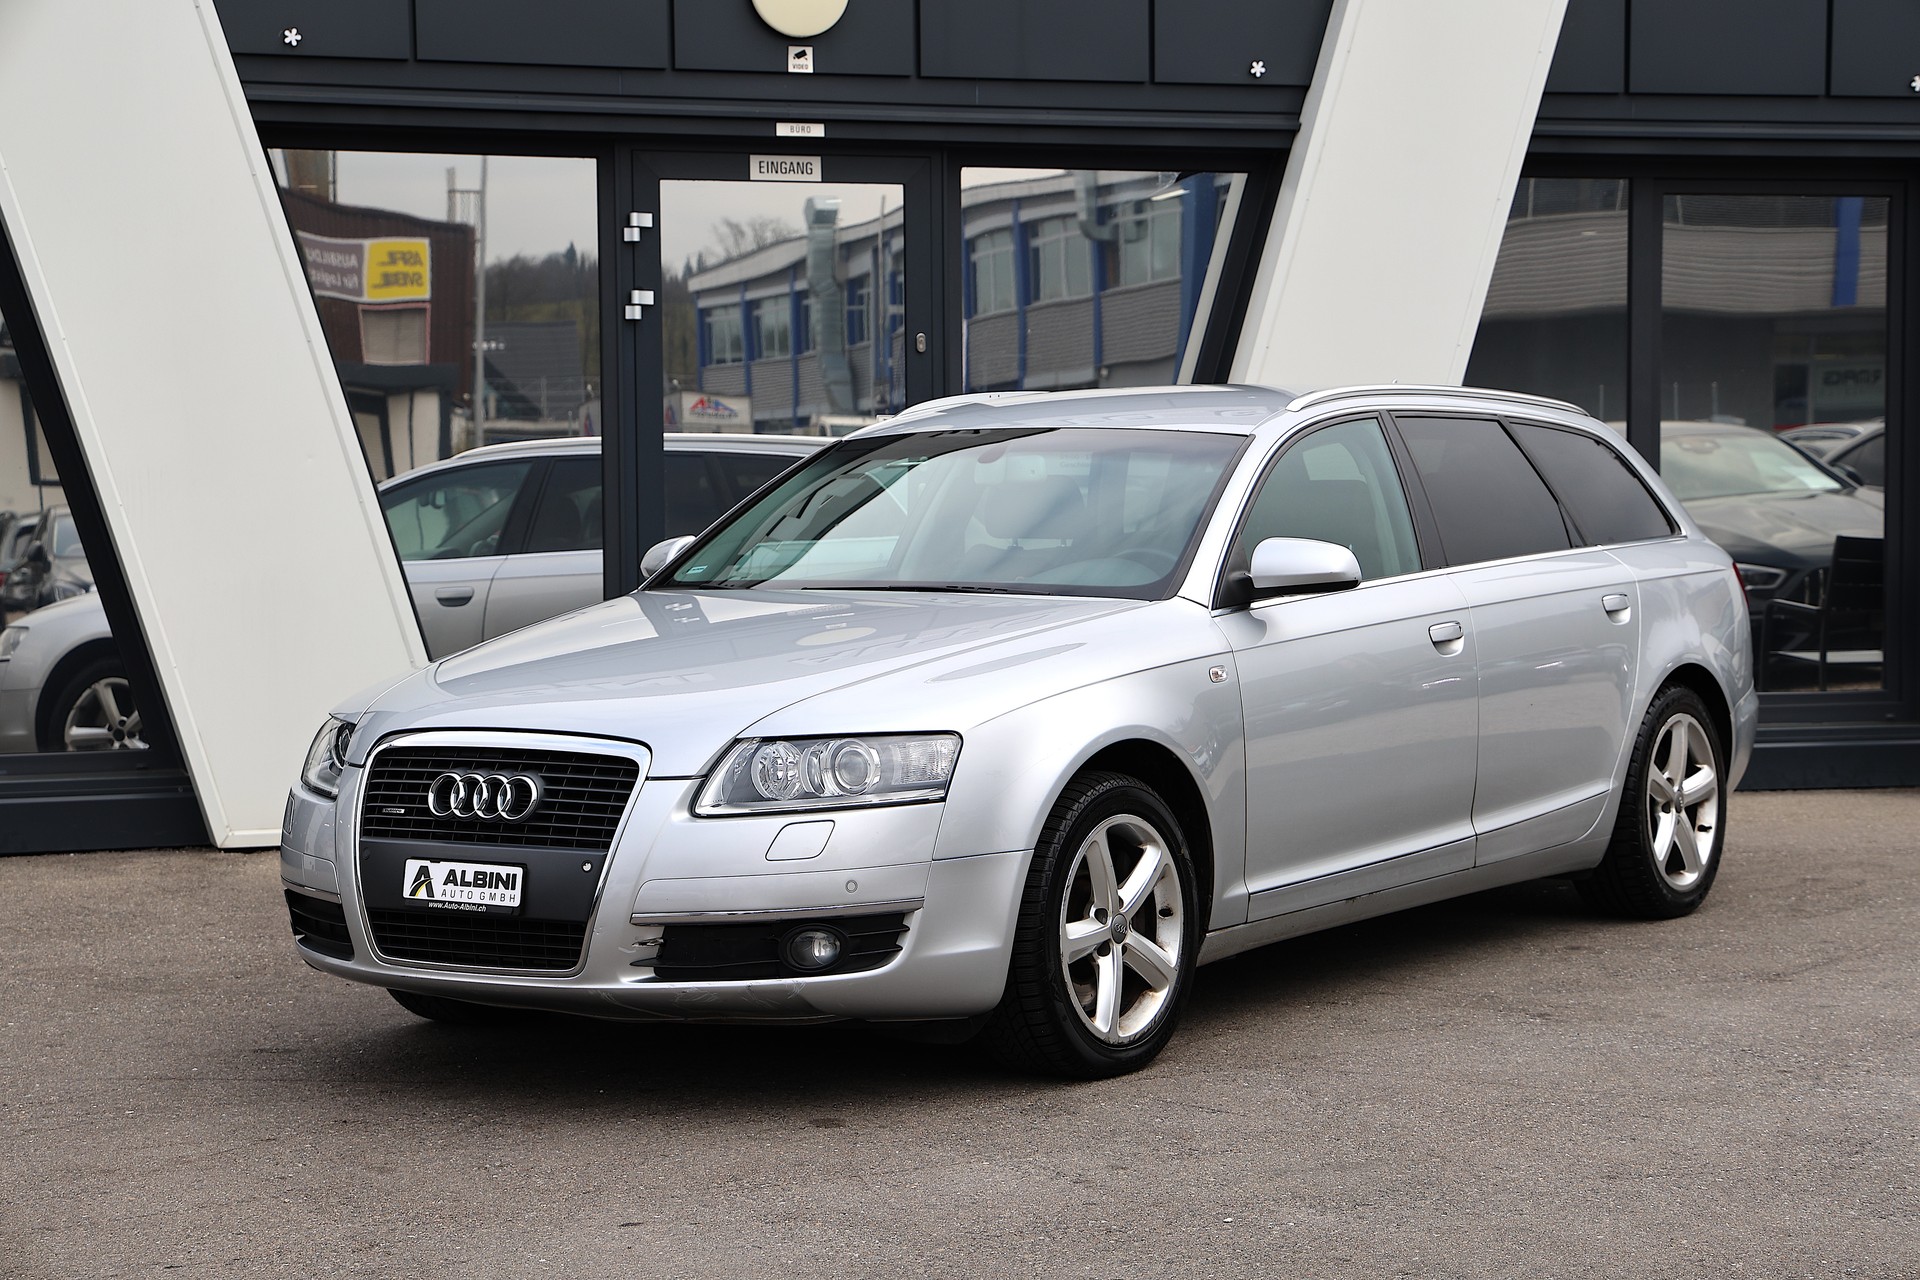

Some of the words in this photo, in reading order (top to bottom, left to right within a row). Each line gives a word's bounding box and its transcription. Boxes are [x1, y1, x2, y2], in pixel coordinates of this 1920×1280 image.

[790, 124, 812, 134] BÜRO
[758, 160, 813, 175] EINGANG
[443, 869, 518, 891] ALBINI
[441, 888, 473, 900] AUTO
[479, 891, 516, 903] GMBH
[428, 902, 487, 912] www.Auto-Albini.ch
